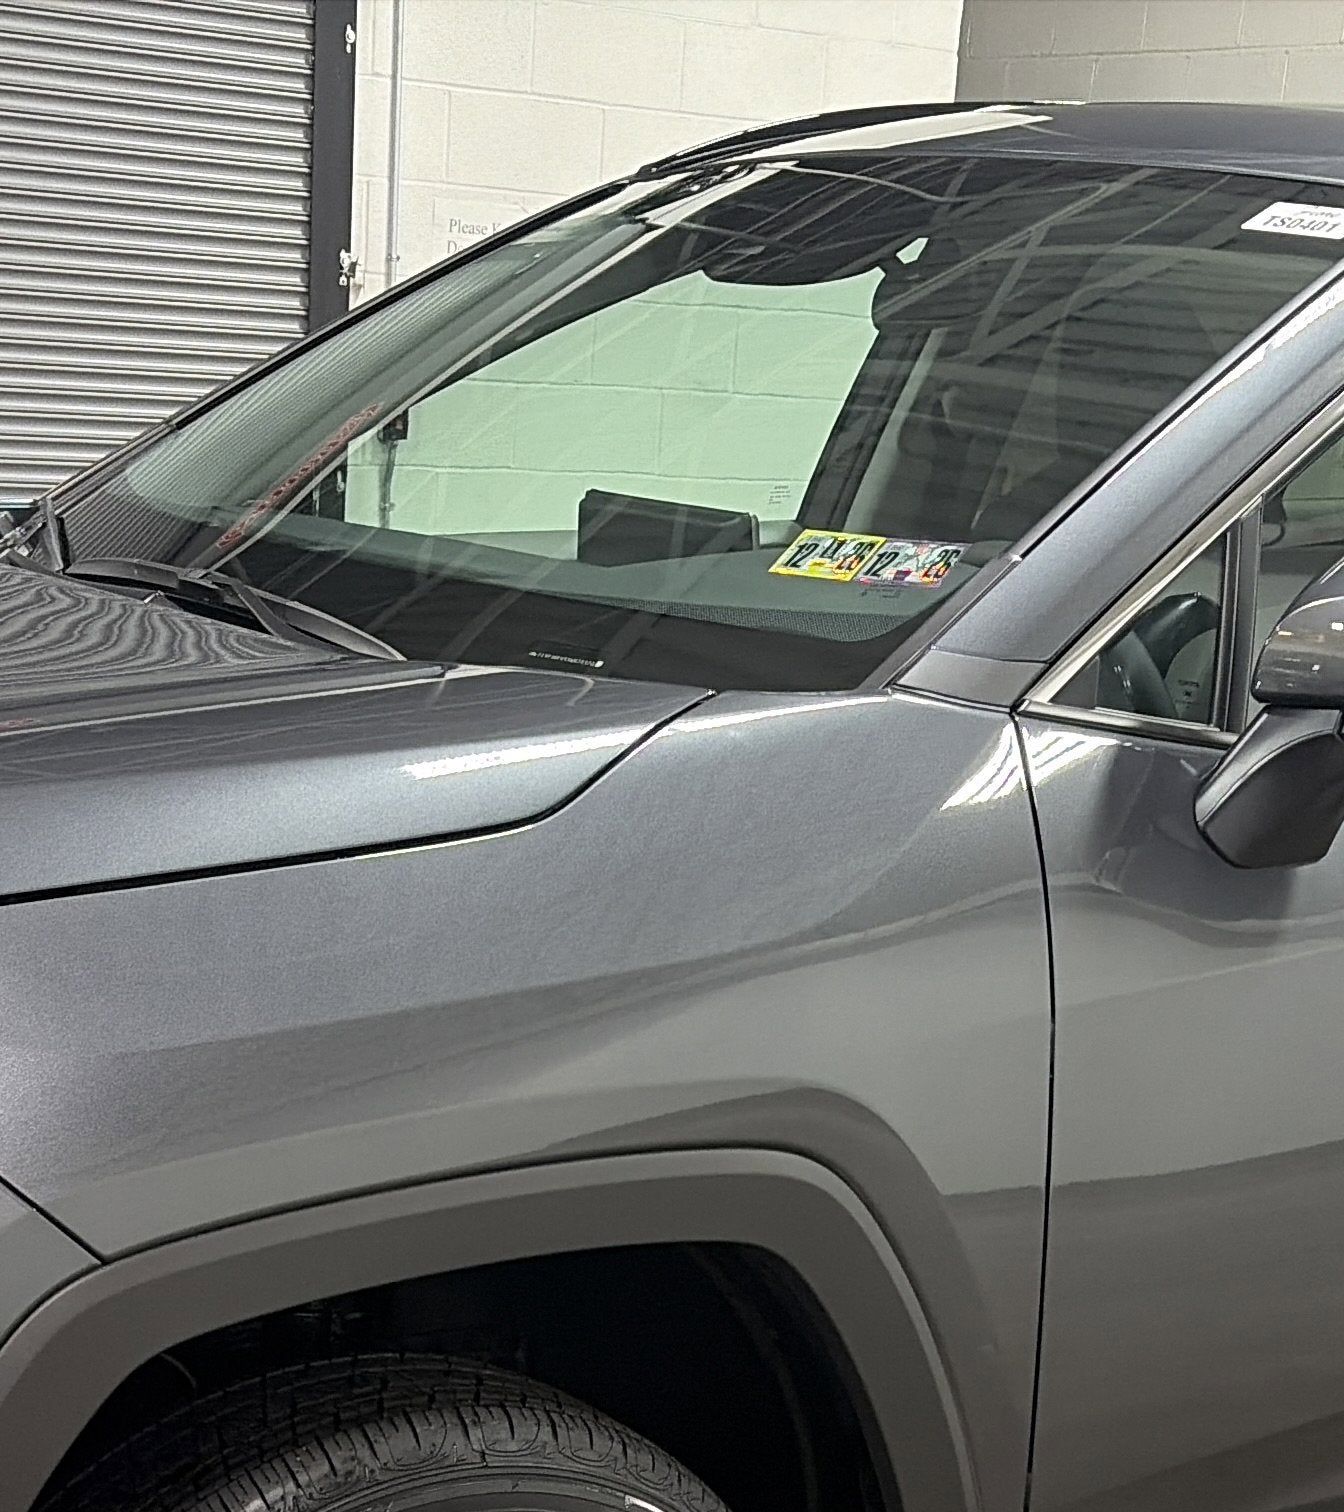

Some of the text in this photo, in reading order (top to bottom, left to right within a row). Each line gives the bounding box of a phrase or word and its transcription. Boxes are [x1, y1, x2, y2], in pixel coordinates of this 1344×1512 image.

[448, 218, 488, 235] Please
[784, 542, 819, 568] 12
[864, 551, 899, 577] 12
